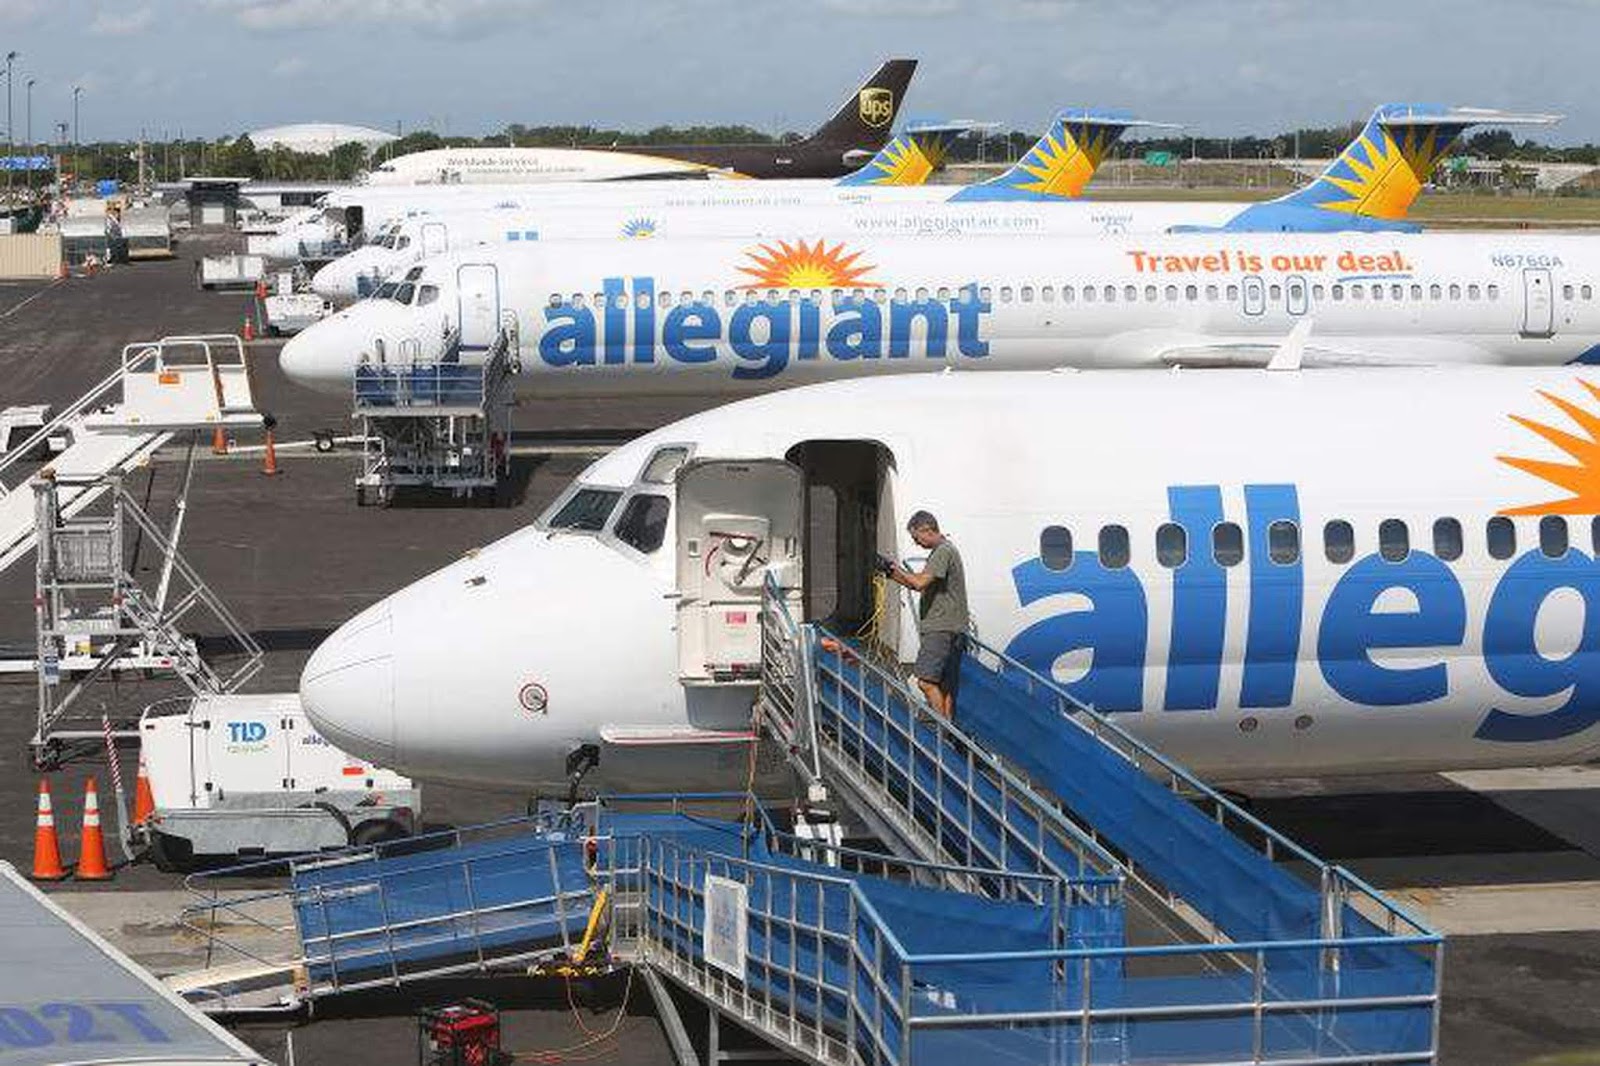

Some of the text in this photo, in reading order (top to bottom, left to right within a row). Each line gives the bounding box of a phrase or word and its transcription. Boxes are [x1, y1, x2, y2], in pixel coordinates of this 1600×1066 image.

[861, 98, 892, 123] ups
[1127, 250, 1413, 273] Travel is our deal.
[538, 276, 992, 380] allegiant
[1004, 483, 1600, 742] alleg
[227, 722, 267, 743] TLD
